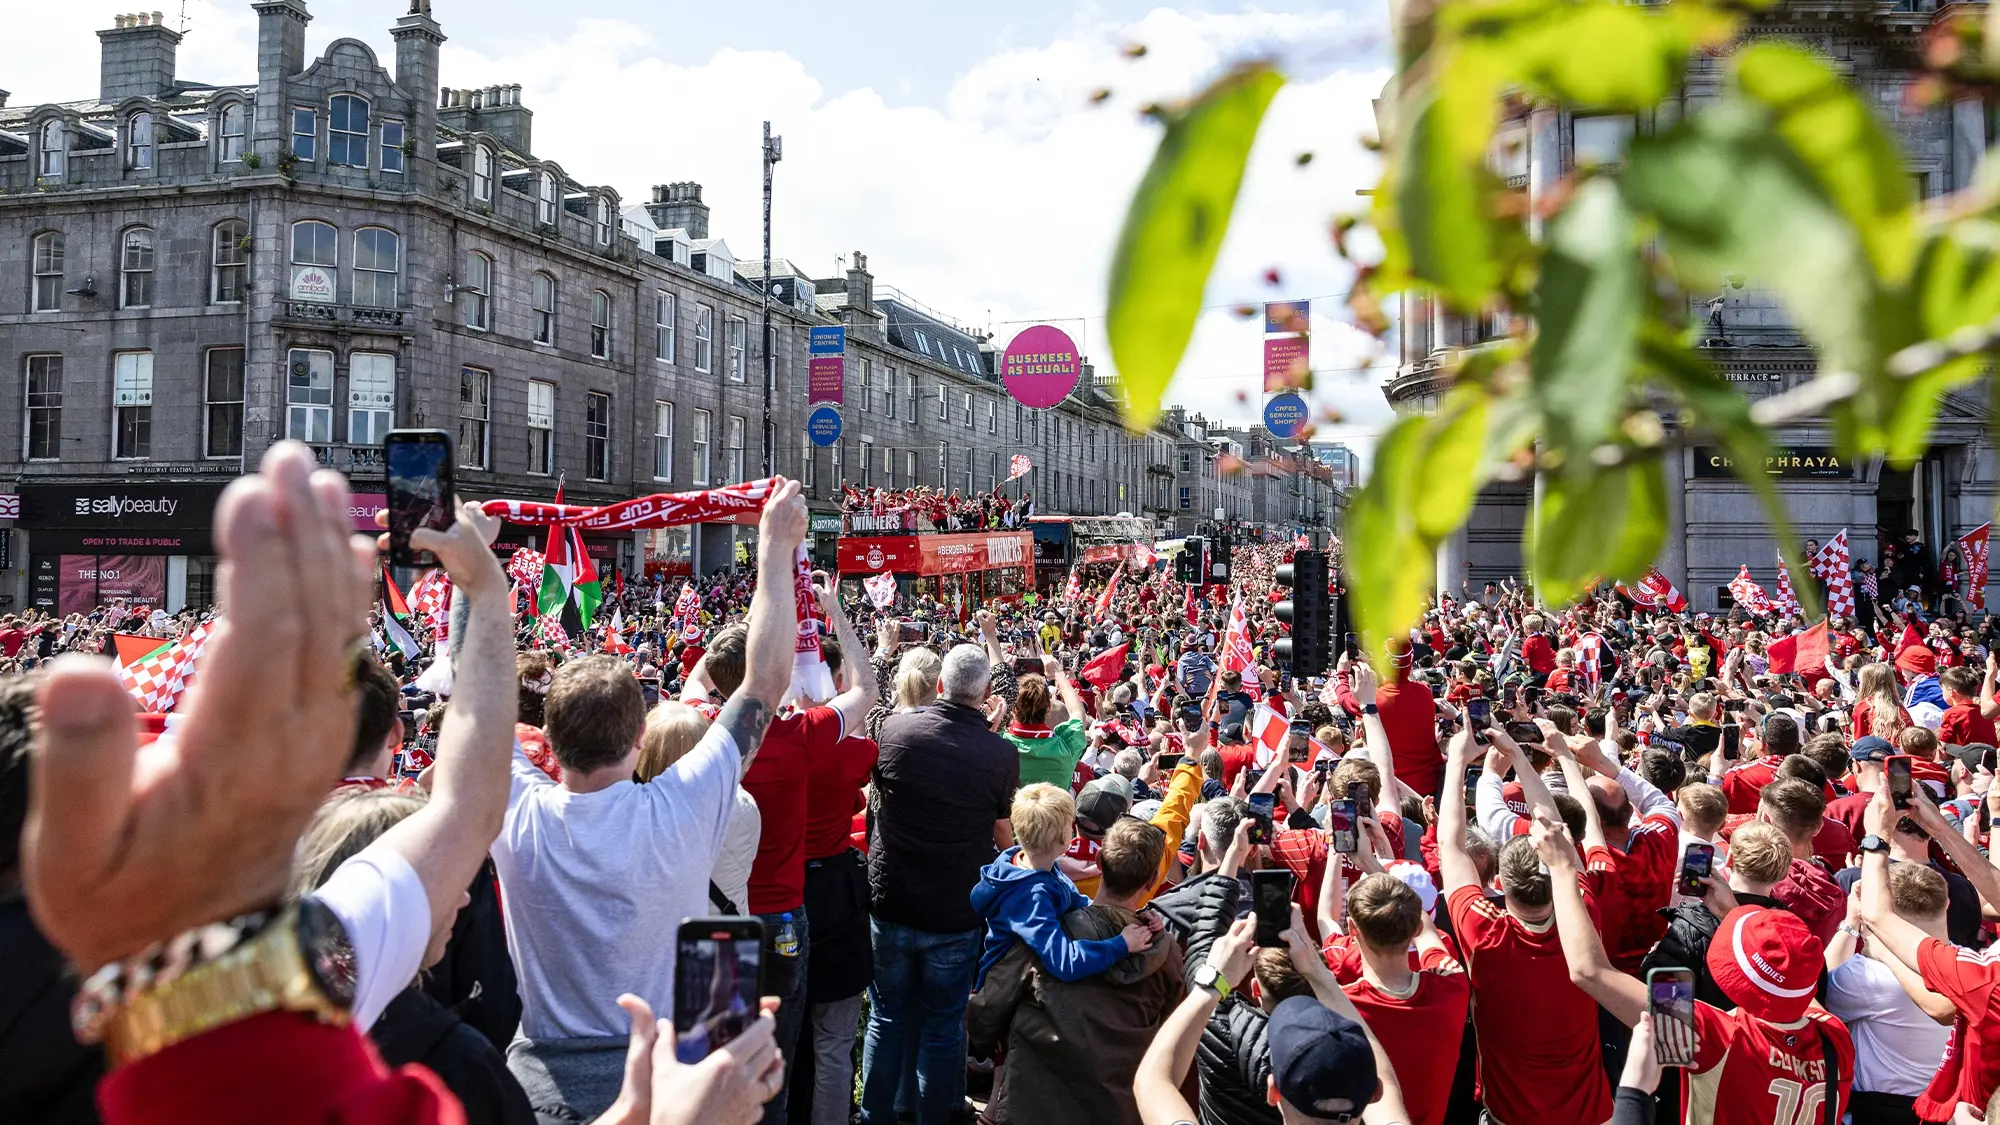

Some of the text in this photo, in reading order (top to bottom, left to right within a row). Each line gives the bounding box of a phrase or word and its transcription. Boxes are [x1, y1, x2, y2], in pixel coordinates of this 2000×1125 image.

[1008, 352, 1072, 364] BUSINESS
[1008, 364, 1075, 376] AS USUAL!
[1724, 373, 1768, 381] TERRACE
[1710, 456, 1840, 468] CHPHRAYA
[708, 490, 757, 508] FINAL
[620, 501, 653, 520] CUP
[852, 515, 900, 530] WINNERS
[937, 543, 974, 556] ABERDEEN FC
[987, 536, 1022, 564] WINNERS
[78, 570, 120, 580] THE NO.1
[602, 564, 612, 574] ghd
[1508, 800, 1530, 814] SHIN
[1751, 951, 1786, 984] DANDIES
[1769, 1044, 1840, 1082] CLARKSO
